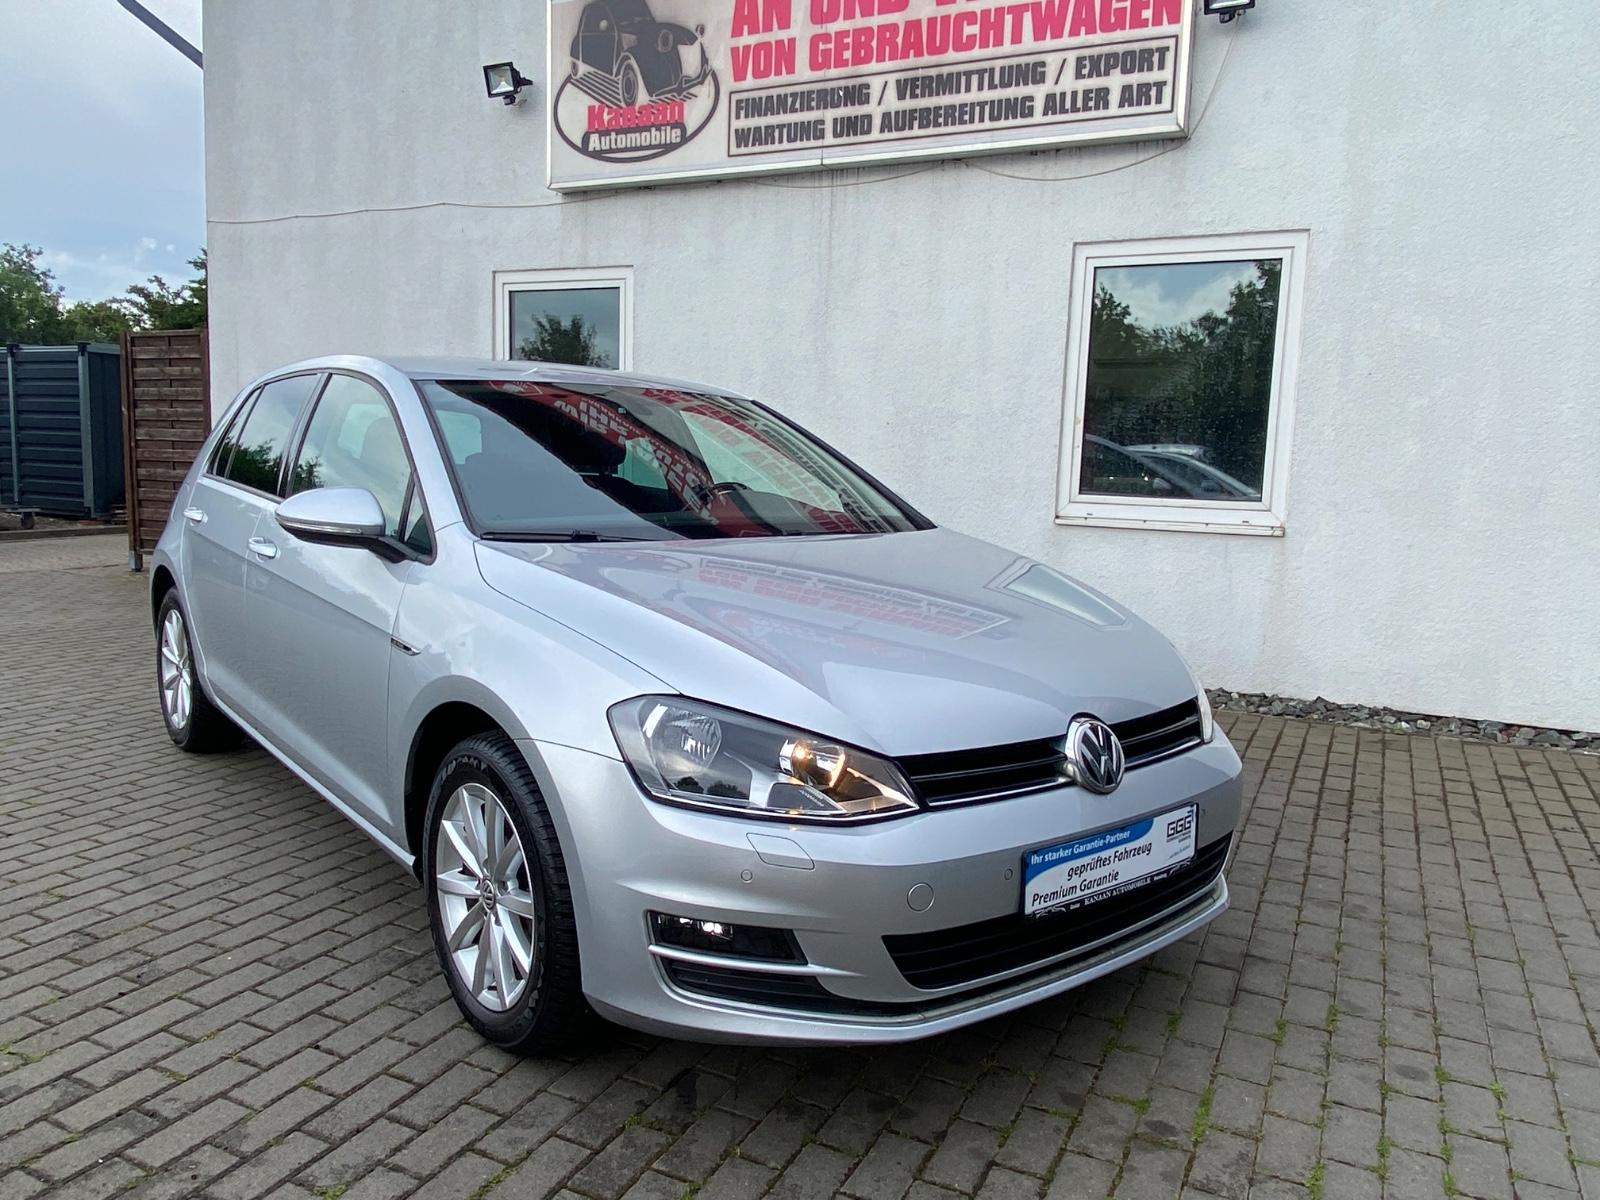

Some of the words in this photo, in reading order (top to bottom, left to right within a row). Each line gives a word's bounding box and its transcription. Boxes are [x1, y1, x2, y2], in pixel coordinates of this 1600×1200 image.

[730, 0, 792, 38] AN
[730, 37, 797, 82] VON
[808, 0, 1182, 72] GEBRAUCHTWAGEN
[896, 60, 1047, 101] VERMITTLUNG
[1074, 46, 1170, 81] EXPORT
[587, 100, 685, 132] Kanaan
[735, 119, 826, 149] WARTUNG
[832, 114, 872, 139] UND
[880, 95, 1035, 134] AUFBEREITUNG
[1042, 87, 1111, 117] ALLER
[1118, 81, 1168, 109] ART
[588, 126, 682, 152] Automobile
[1031, 854, 1044, 865] Ihr
[1044, 848, 1072, 861] starker
[1073, 830, 1131, 855] Garantie-Partner
[1067, 854, 1112, 881] geprüftes
[1112, 842, 1152, 864] Fahrzeug
[1031, 885, 1078, 907] Premium
[1079, 869, 1120, 892] Garantie
[1112, 877, 1152, 897] AUTOMOBILE
